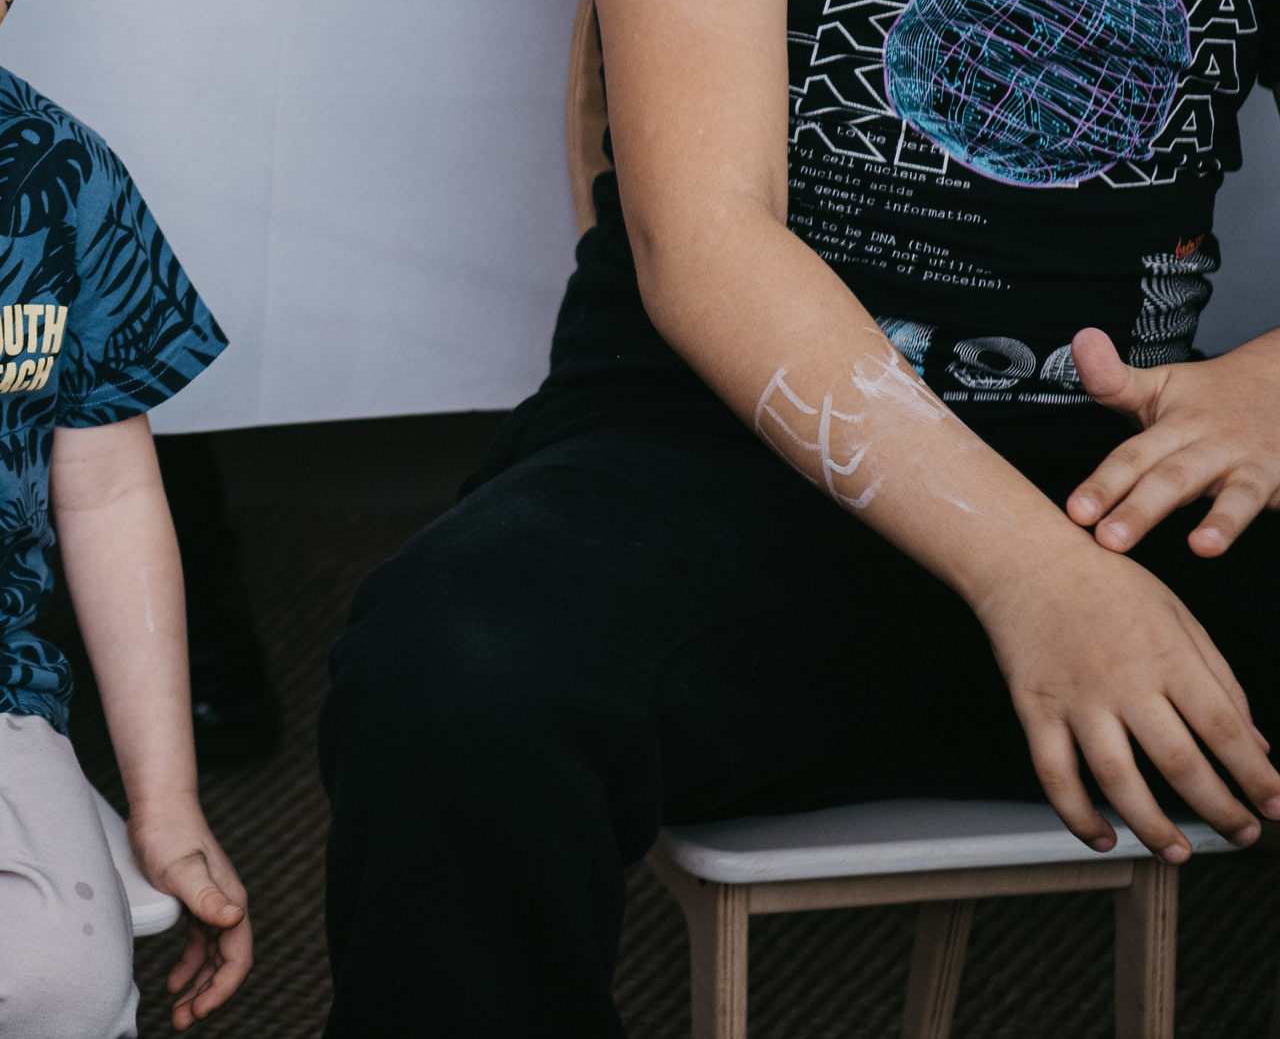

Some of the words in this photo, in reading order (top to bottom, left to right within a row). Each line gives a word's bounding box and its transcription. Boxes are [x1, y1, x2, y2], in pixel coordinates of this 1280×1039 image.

[836, 125, 856, 139] to
[867, 131, 887, 145] be
[800, 165, 861, 186] nucleic
[870, 181, 914, 197] acids
[822, 152, 855, 169] cell
[864, 162, 927, 183] nucleus
[935, 174, 972, 190] does
[788, 177, 806, 190] de
[814, 183, 876, 207] genetic
[819, 199, 864, 216] their
[788, 212, 813, 227] red
[822, 219, 838, 232] to
[846, 225, 862, 238] be
[871, 231, 897, 247] DNA
[907, 239, 950, 258] (thus
[818, 250, 888, 269] ynthesis
[896, 262, 916, 276] of
[891, 249, 919, 263] not
